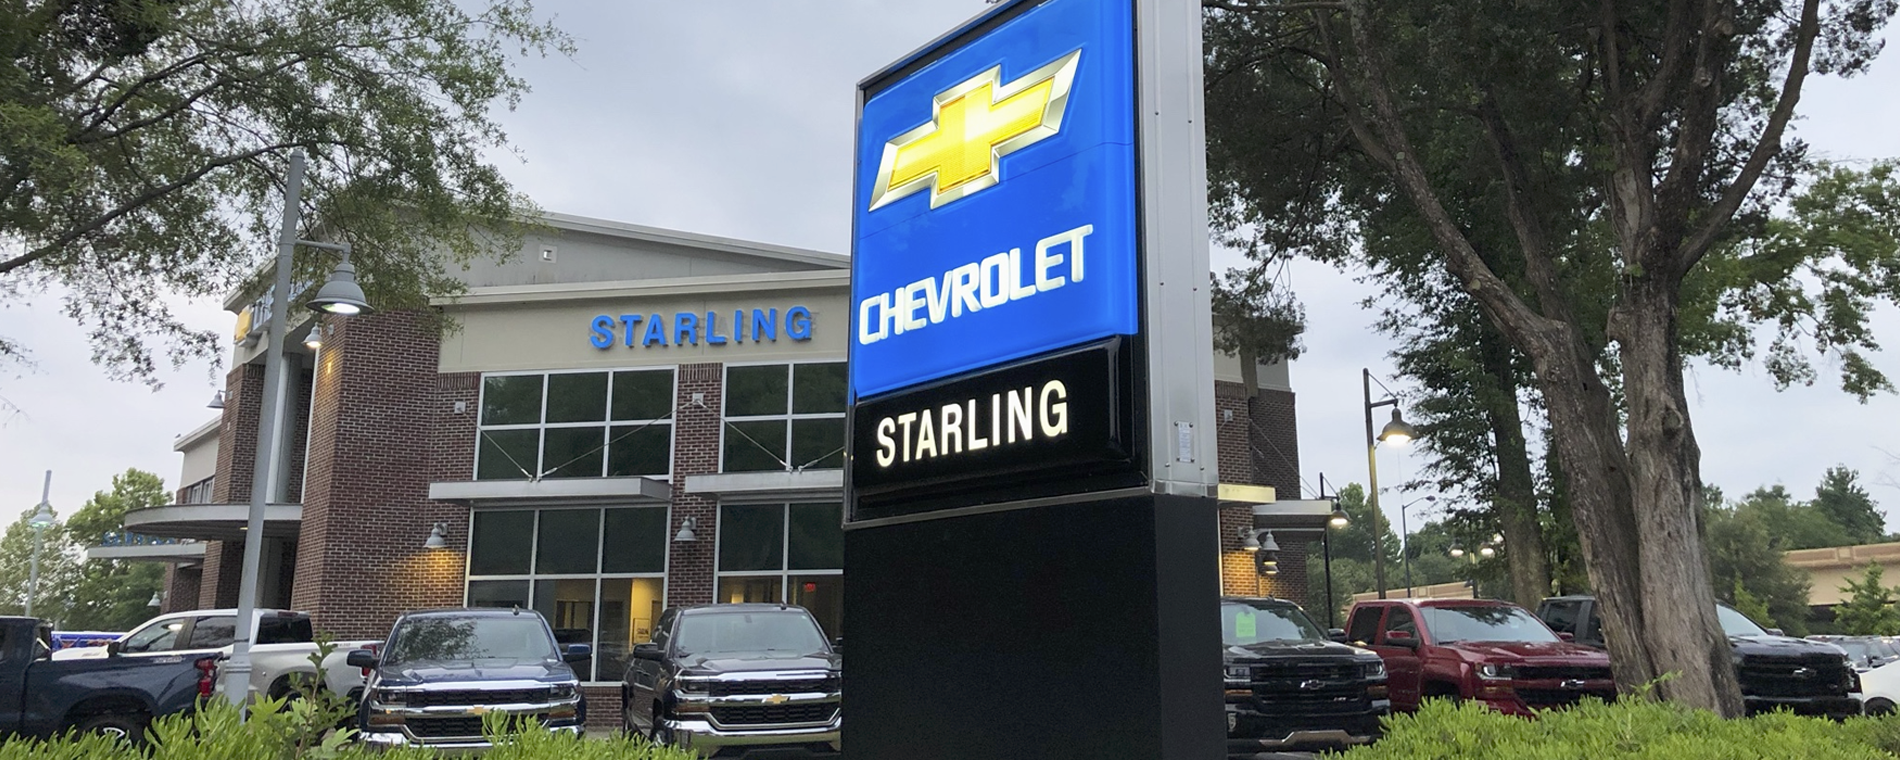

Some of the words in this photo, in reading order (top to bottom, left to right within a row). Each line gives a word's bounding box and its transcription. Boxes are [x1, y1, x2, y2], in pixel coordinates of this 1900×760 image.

[590, 306, 813, 349] STARLING
[859, 224, 1094, 345] CHEVROLET
[876, 379, 1068, 467] STARLING
